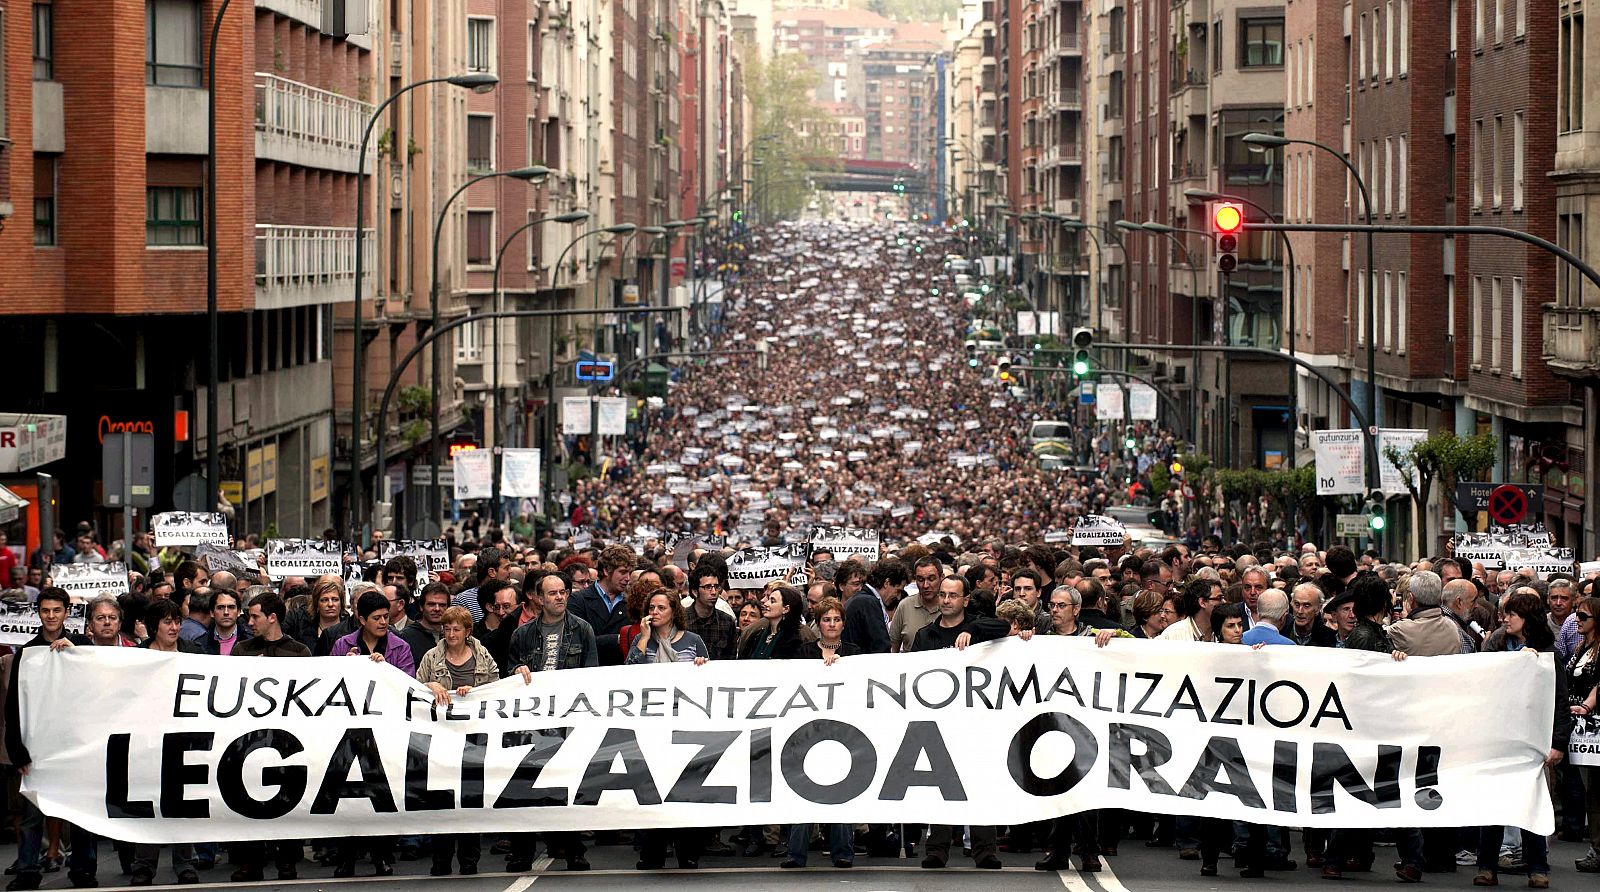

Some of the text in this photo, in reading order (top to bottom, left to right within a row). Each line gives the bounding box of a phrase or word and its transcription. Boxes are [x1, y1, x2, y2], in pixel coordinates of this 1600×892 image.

[1470, 488, 1493, 497] Hotel
[1476, 498, 1489, 507] Ze
[1075, 531, 1123, 539] LEGALIZAZIOA
[173, 663, 1353, 731] EUSKAL HERRIARENTZAT NORMALIZAZIOA
[105, 711, 1444, 820] LEGALIZAZIOA ORAIN!
